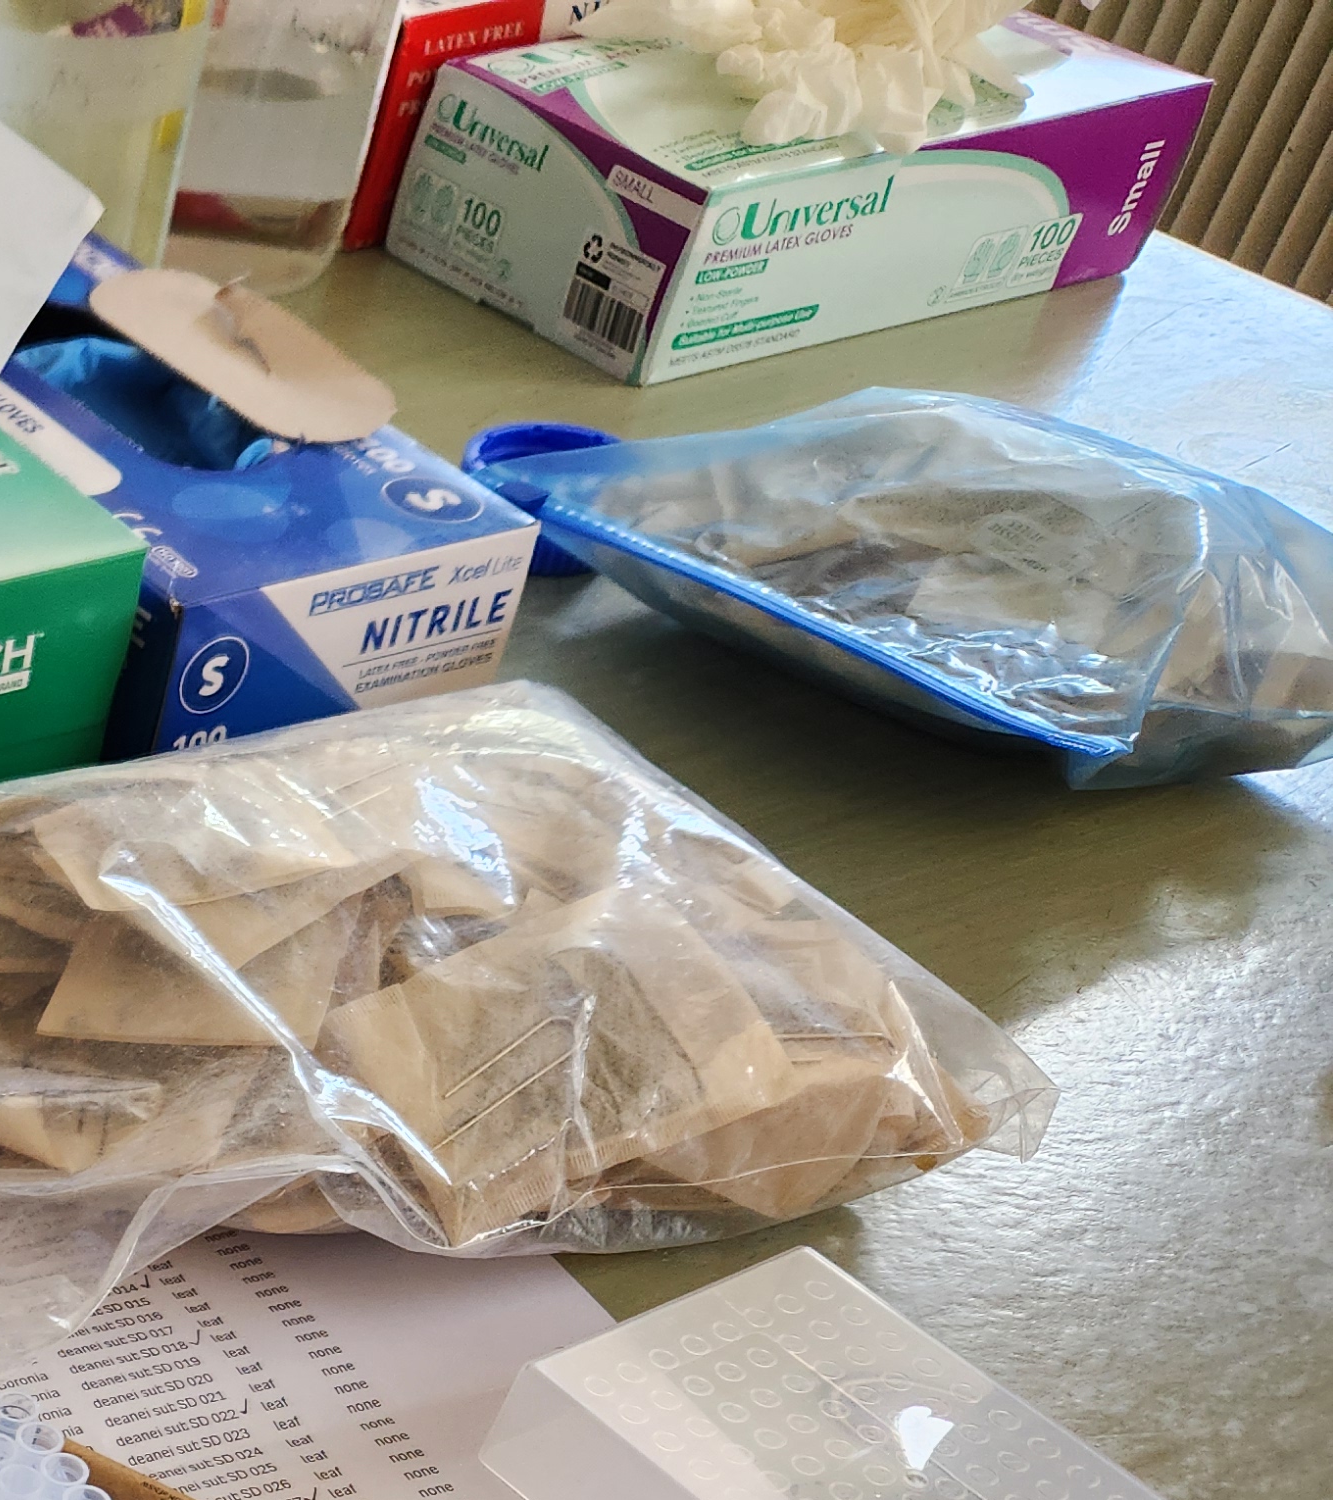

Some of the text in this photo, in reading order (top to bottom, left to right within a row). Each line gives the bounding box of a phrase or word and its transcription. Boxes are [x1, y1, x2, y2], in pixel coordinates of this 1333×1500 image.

[424, 21, 524, 56] LATEX FREE
[612, 170, 654, 203] SMALL
[1107, 139, 1165, 236] Small
[462, 197, 501, 237] 100
[739, 175, 895, 241] Universal
[704, 224, 854, 266] PREMIUM LATEX GLOVES
[1030, 218, 1077, 252] 100
[697, 260, 768, 284] LOW-POWDER
[1018, 248, 1065, 268] PIECES
[405, 488, 461, 512] S
[308, 555, 523, 616] PROSAFE Xcel Lite
[360, 588, 513, 655] NITRILE
[198, 654, 230, 697] S
[354, 652, 493, 694] EXAMINATION GLOVES
[69, 1357, 115, 1375] deanei
[139, 1344, 161, 1359] SD
[162, 1340, 189, 1354] 018
[210, 1330, 238, 1344] leaf
[282, 1313, 316, 1328] none
[127, 1447, 174, 1467] deanei
[199, 1433, 221, 1448] SD
[223, 1427, 251, 1443] 023
[272, 1415, 302, 1431] leaf
[346, 1397, 382, 1414] none
